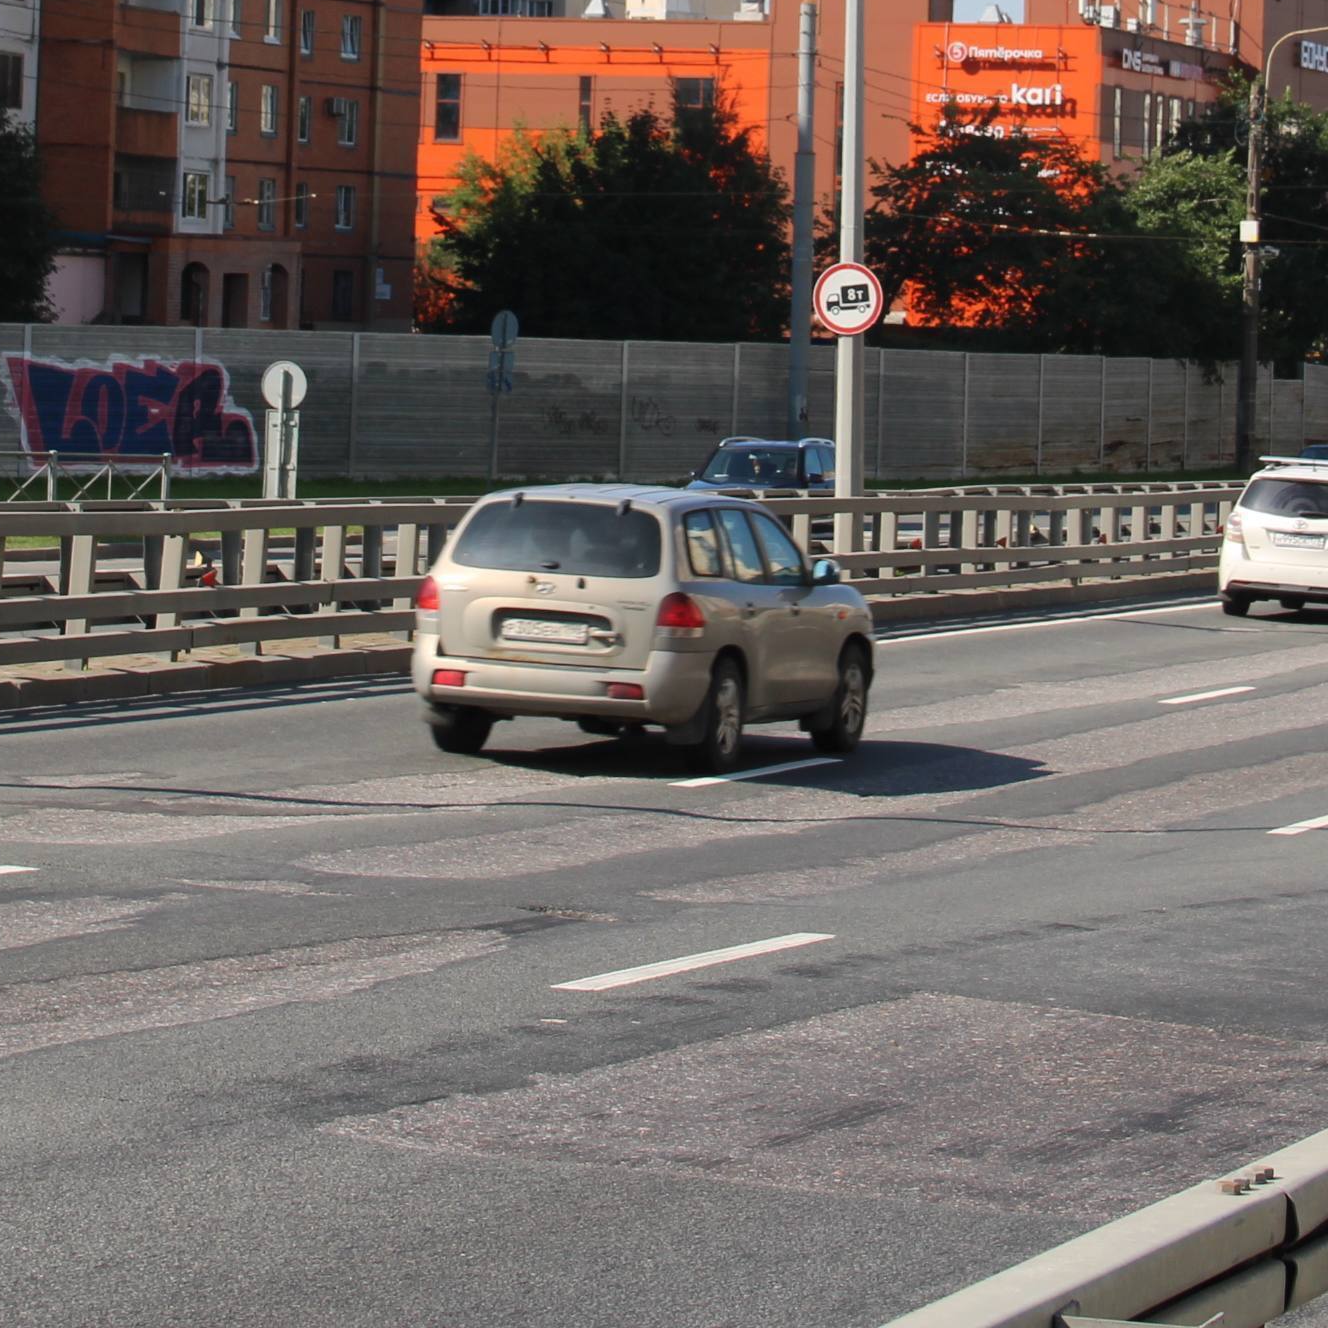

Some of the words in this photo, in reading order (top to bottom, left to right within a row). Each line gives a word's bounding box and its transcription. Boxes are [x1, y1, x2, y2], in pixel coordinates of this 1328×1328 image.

[969, 46, 1043, 61] Пятёрочка
[1122, 48, 1142, 72] DNS
[1011, 83, 1063, 105] kari
